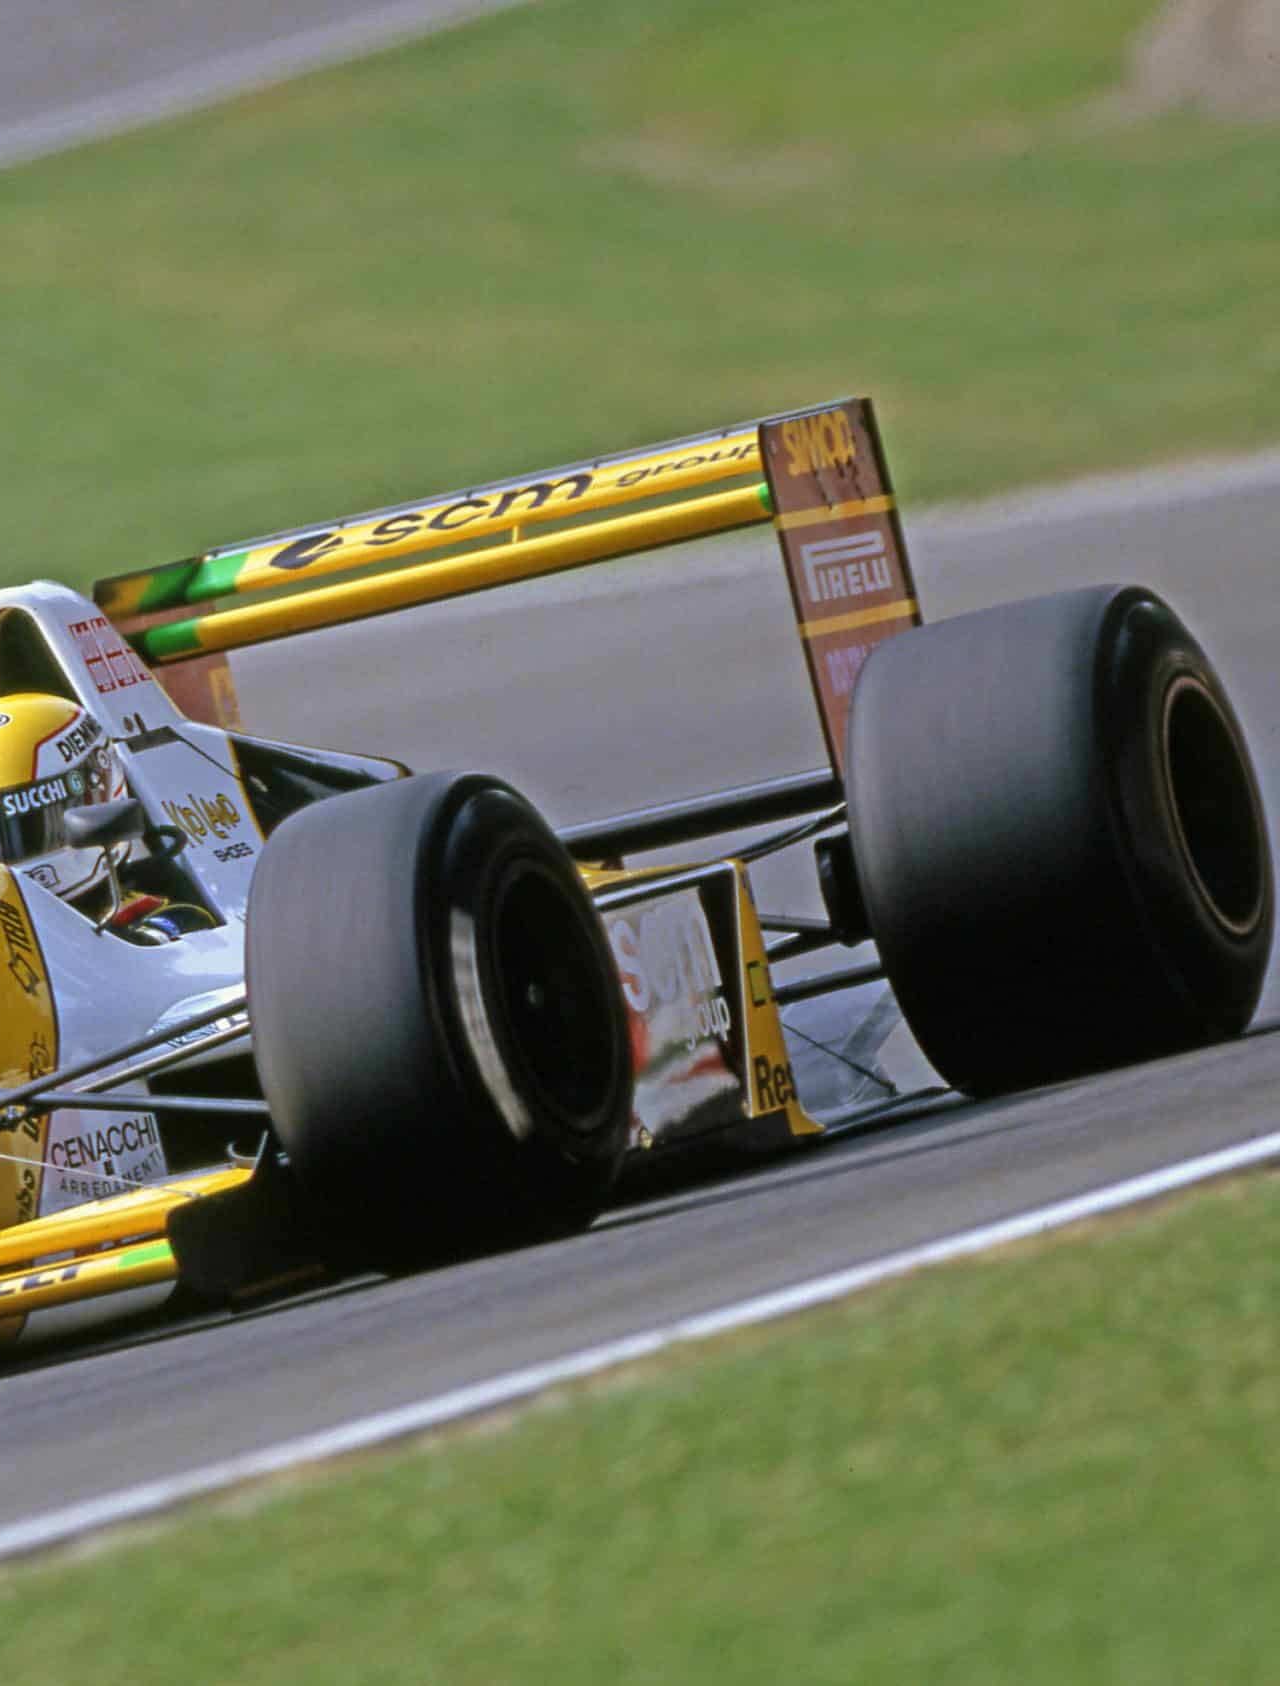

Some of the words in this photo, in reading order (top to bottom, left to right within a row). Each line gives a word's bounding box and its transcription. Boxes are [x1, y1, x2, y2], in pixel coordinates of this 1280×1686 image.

[365, 473, 593, 546] scm
[800, 530, 893, 604] PIRELLI
[2, 778, 68, 818] SUCCHI
[51, 1114, 158, 1172] CENACCHI
